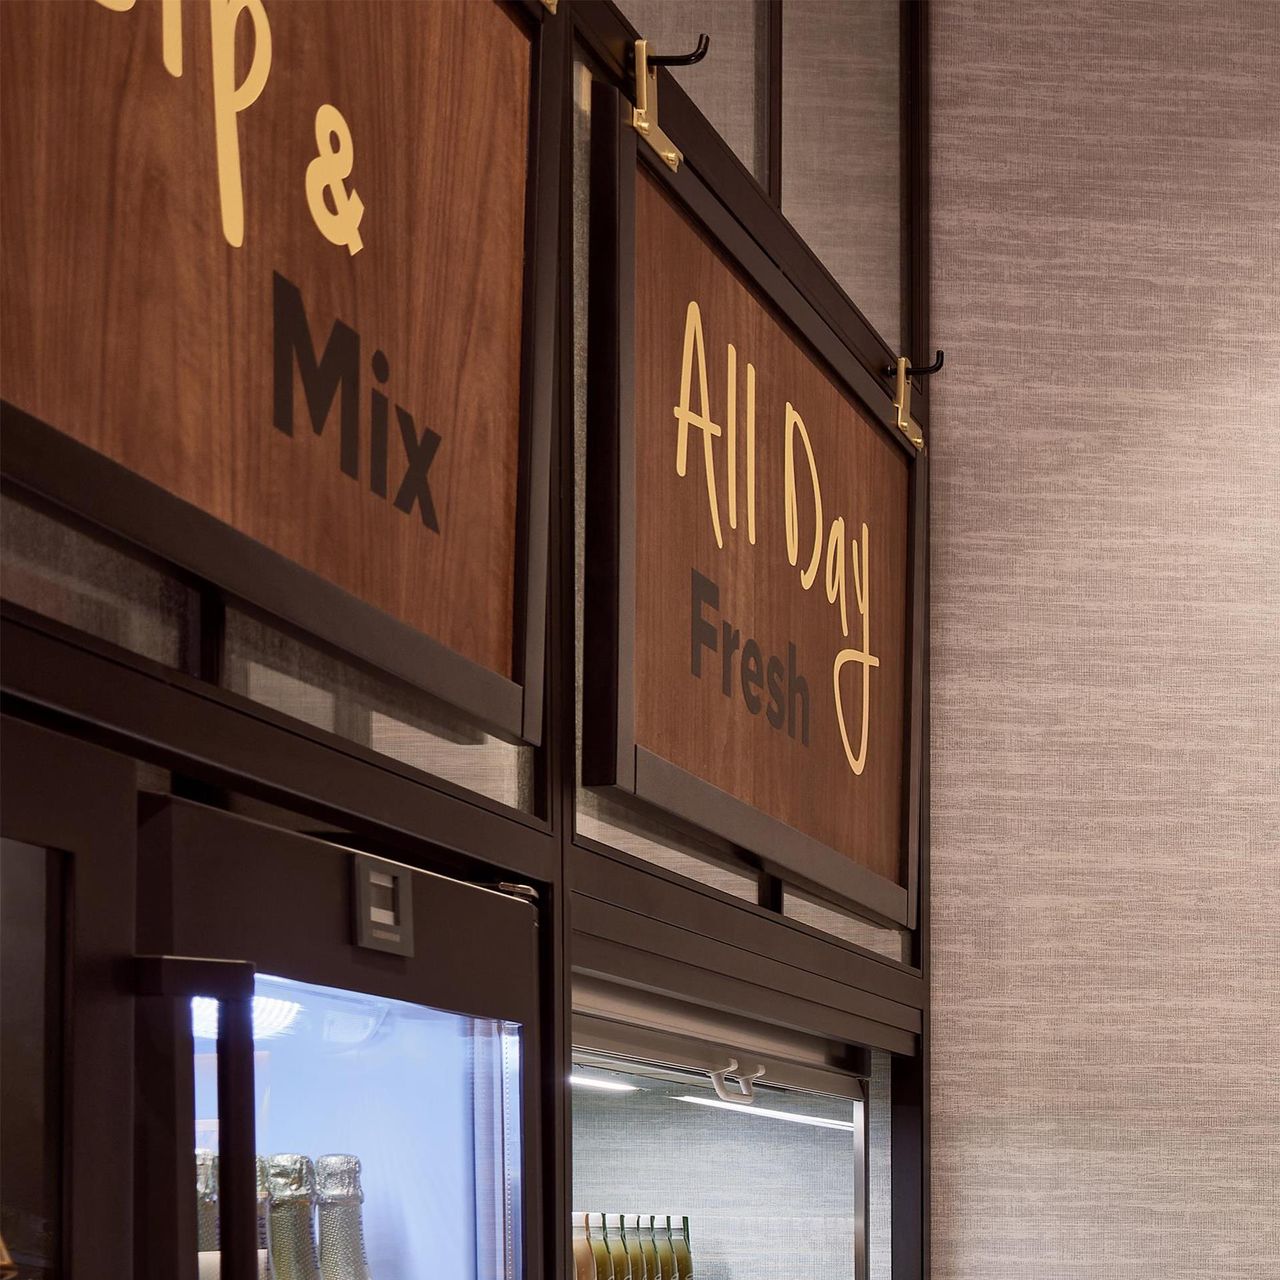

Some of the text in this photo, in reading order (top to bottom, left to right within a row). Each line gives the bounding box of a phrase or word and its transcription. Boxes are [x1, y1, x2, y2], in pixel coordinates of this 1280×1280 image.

[305, 104, 364, 256] &
[273, 270, 441, 534] Mix
[674, 301, 879, 775] All Day
[691, 568, 810, 748] Fresh
